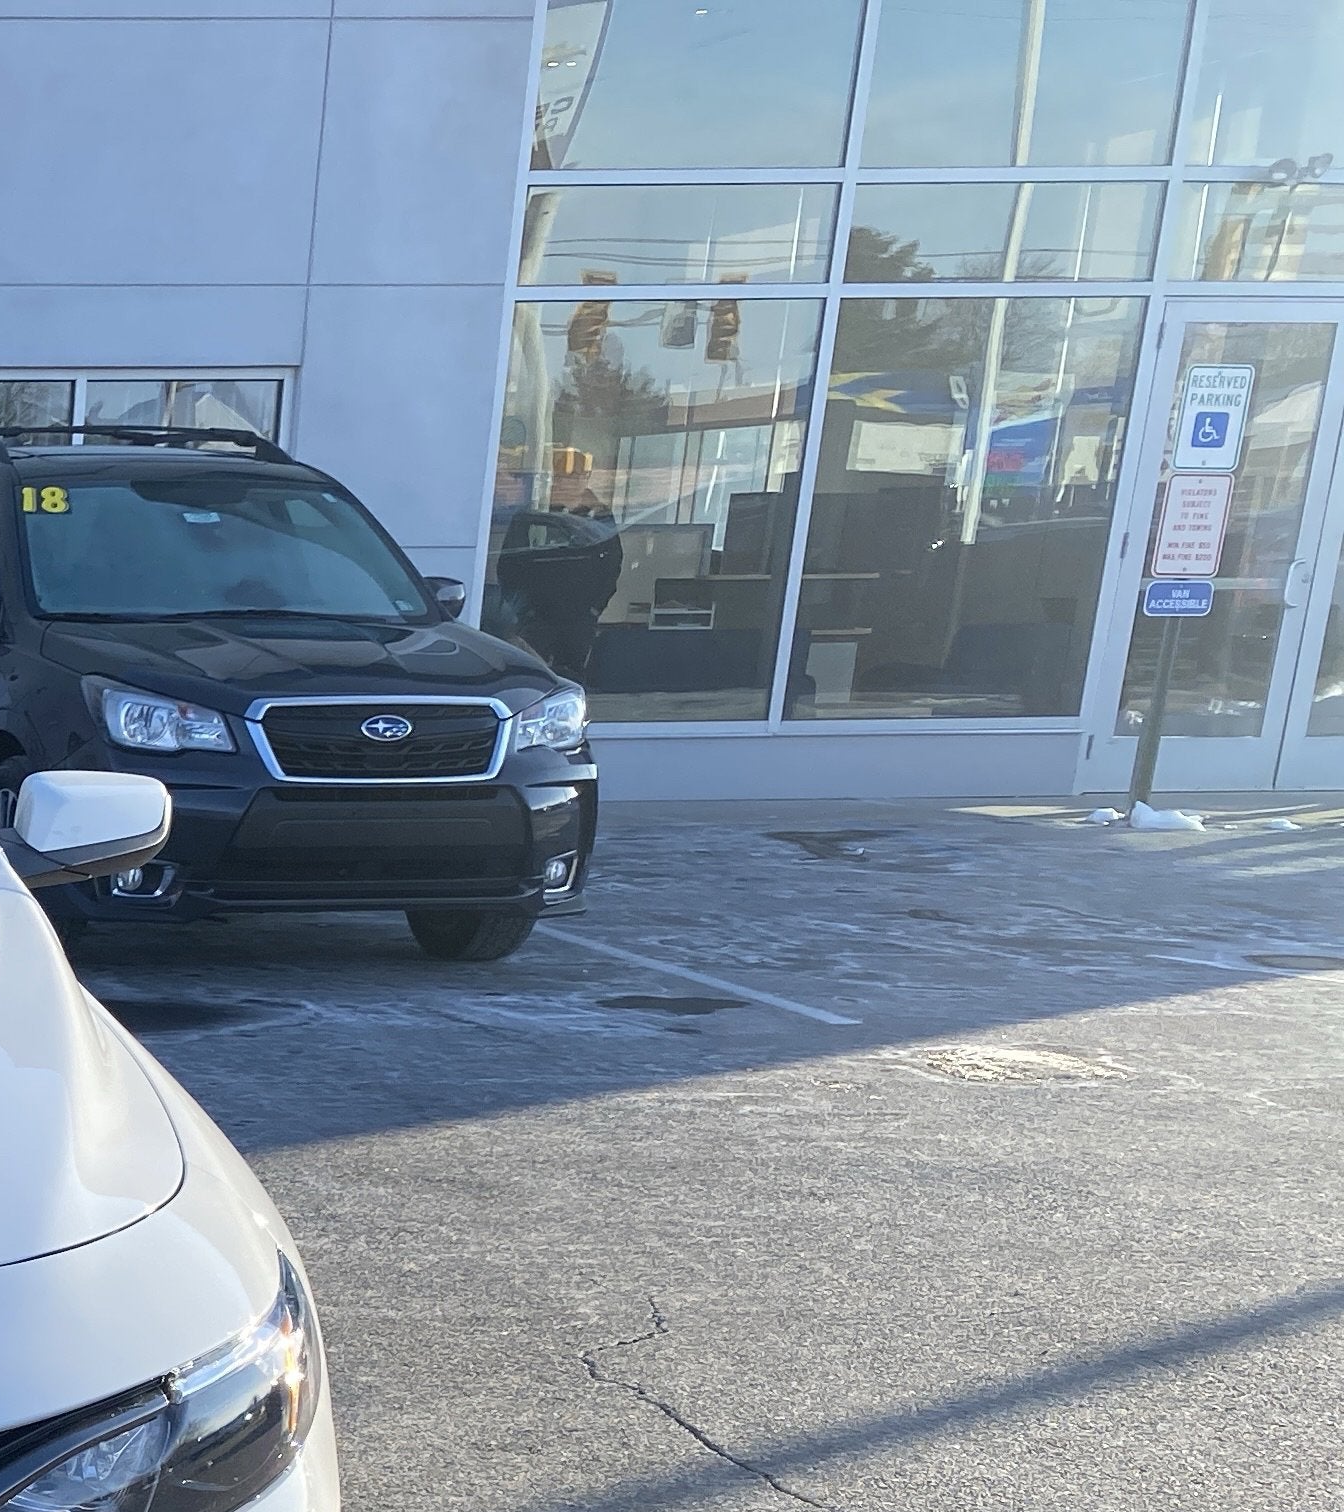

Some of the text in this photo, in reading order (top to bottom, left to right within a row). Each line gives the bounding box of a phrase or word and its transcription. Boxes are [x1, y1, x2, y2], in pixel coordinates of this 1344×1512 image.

[1191, 375, 1247, 389] RESERVED
[1190, 393, 1243, 407] PARKING
[21, 486, 70, 513] 18
[1172, 589, 1190, 599] VAN
[1149, 599, 1208, 609] ACCESSIBLE
